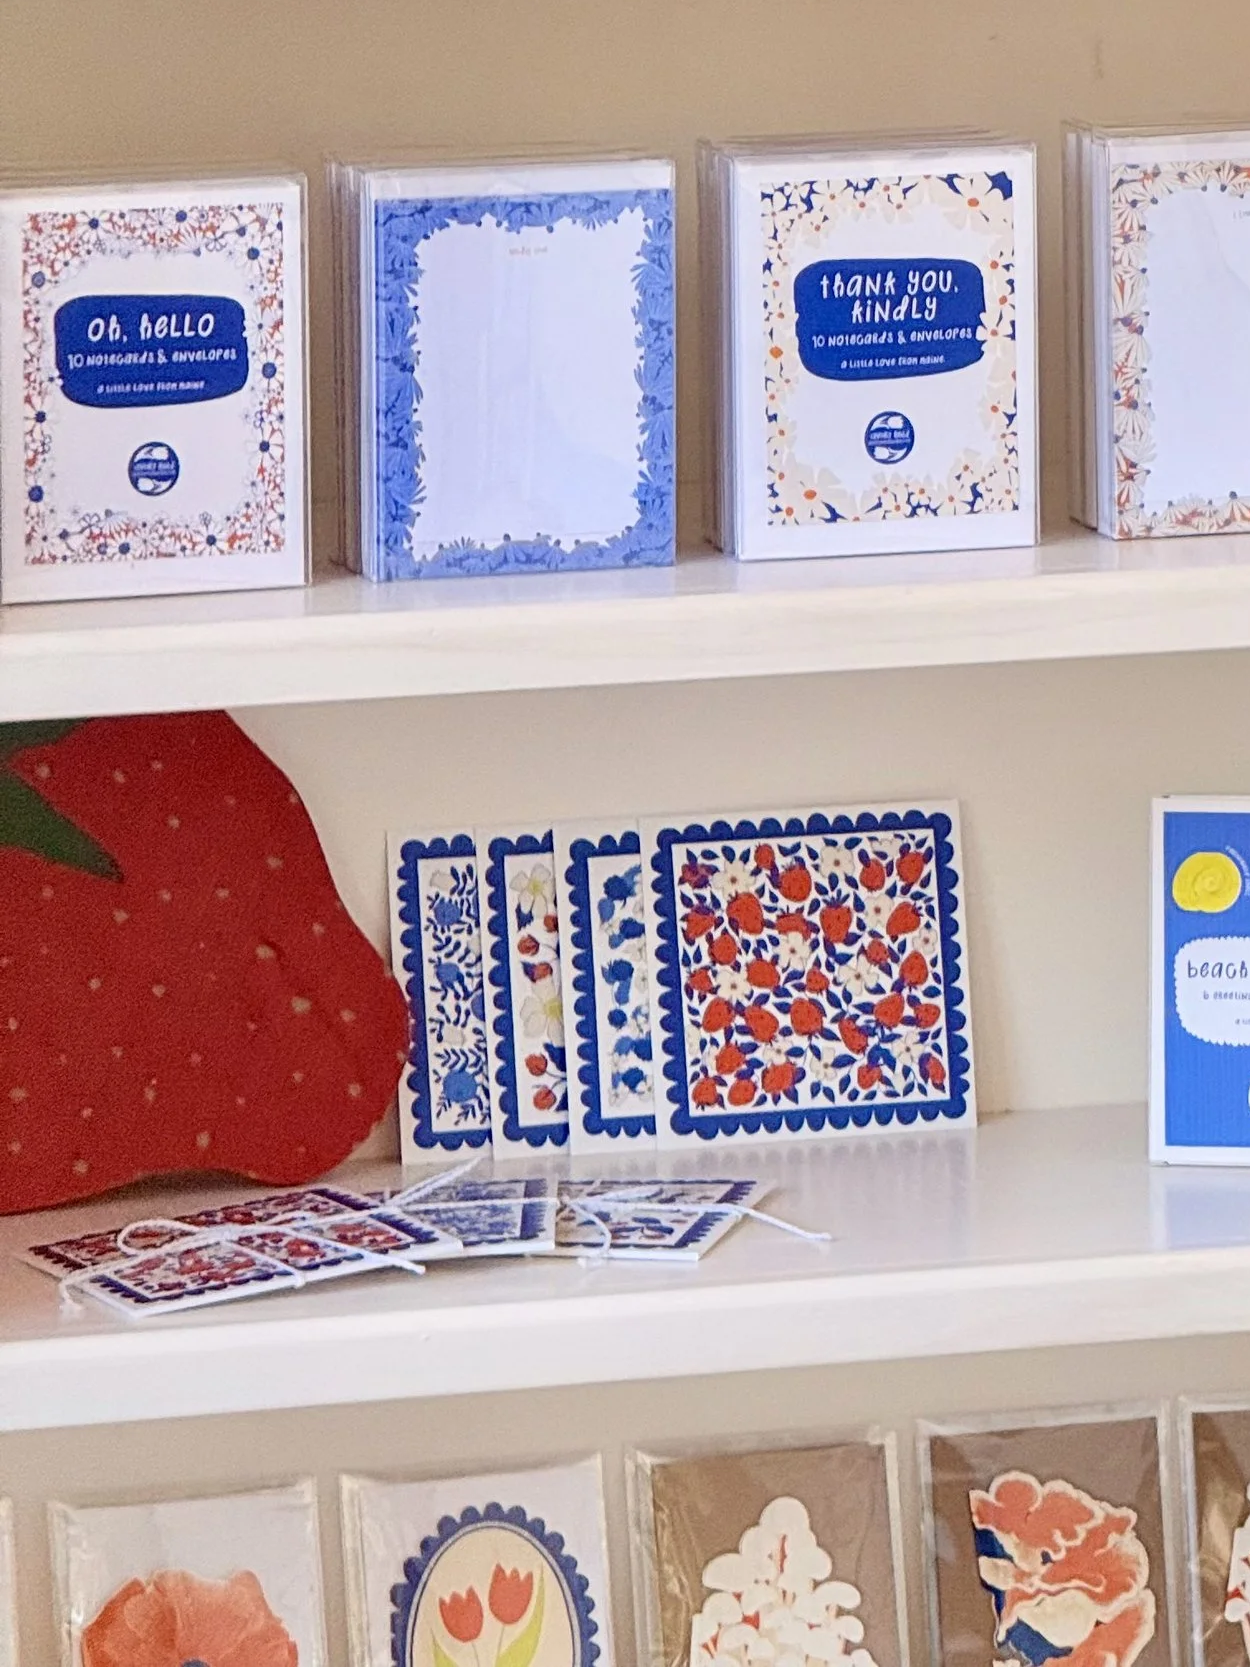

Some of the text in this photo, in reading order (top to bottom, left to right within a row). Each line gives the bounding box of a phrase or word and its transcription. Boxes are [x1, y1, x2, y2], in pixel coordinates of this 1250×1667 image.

[812, 335, 825, 349] 10
[898, 330, 906, 344] &
[68, 353, 84, 370] 10
[157, 348, 168, 365] &
